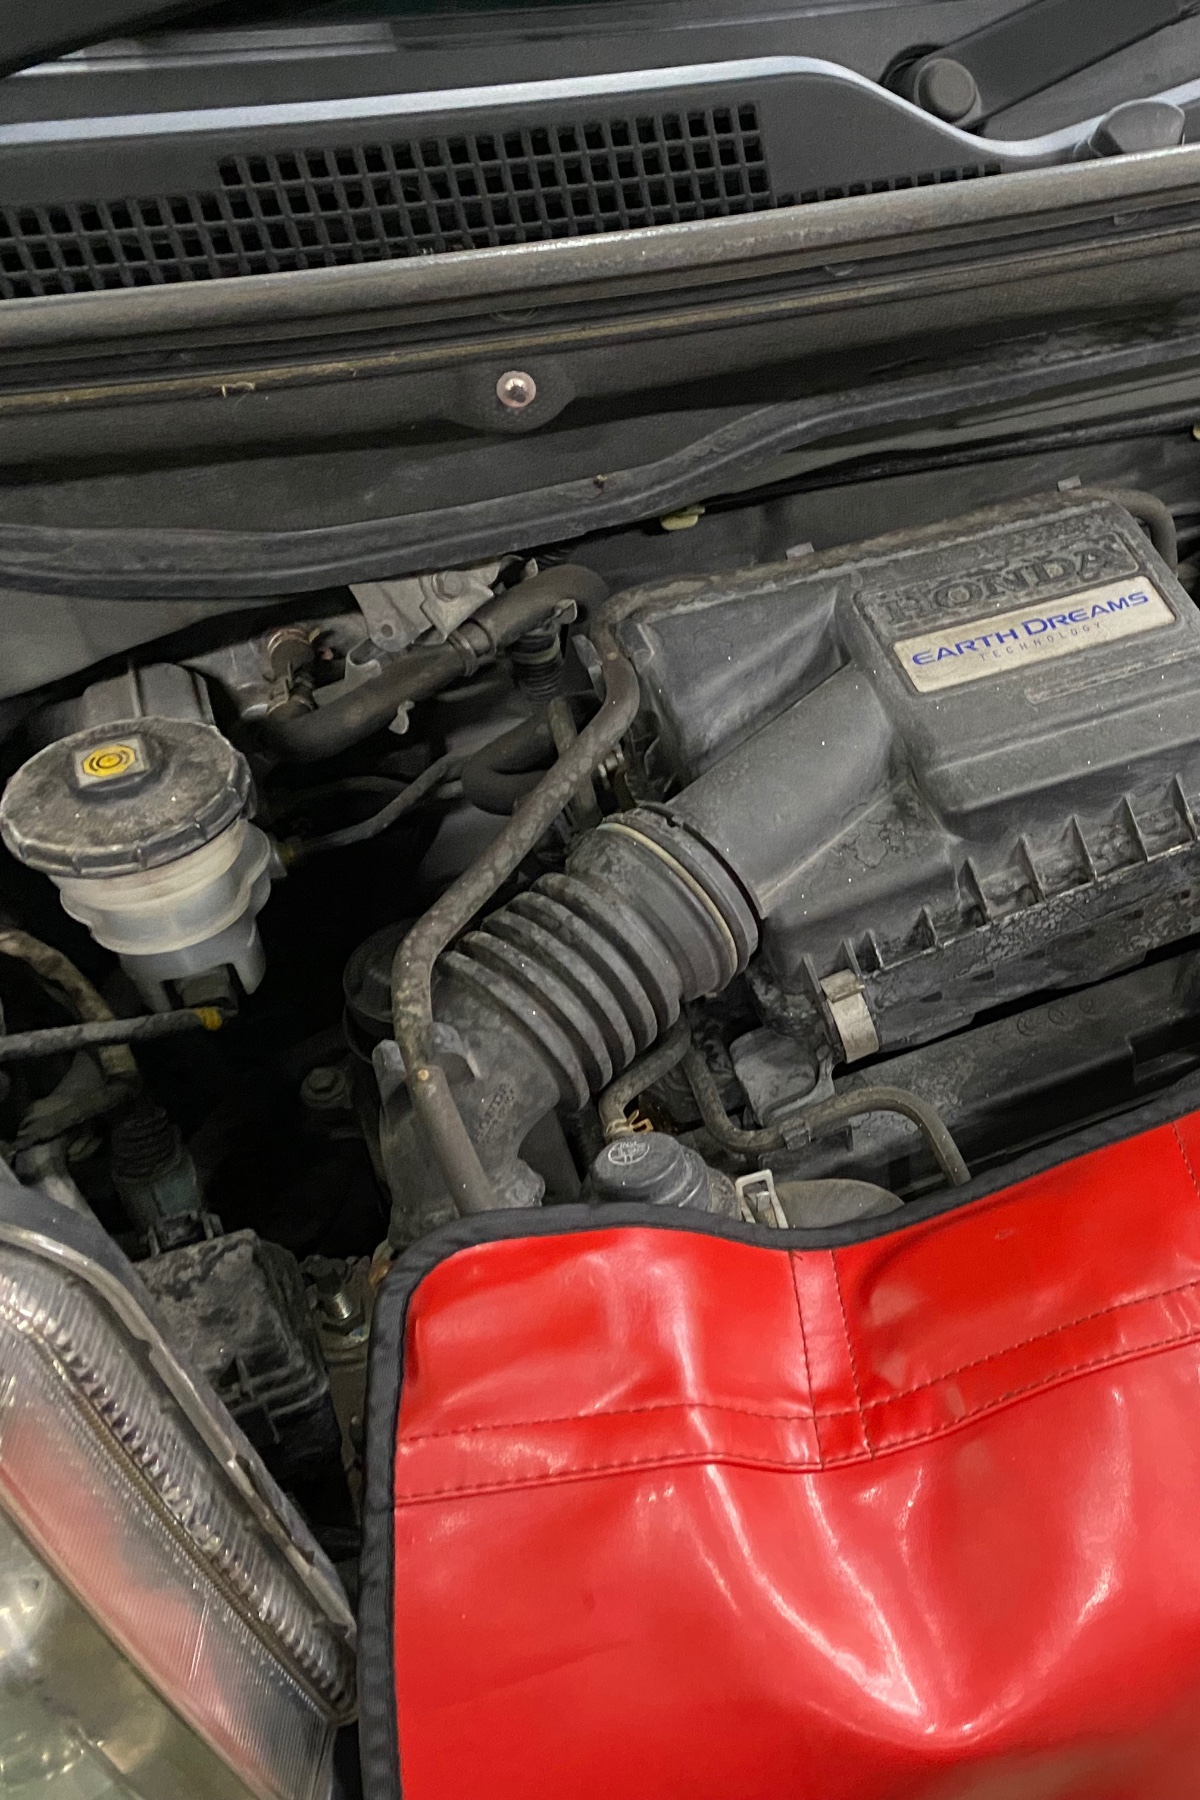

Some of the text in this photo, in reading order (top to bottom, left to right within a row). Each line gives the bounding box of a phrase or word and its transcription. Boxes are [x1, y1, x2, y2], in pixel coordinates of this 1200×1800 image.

[884, 543, 1118, 622] HONDA
[912, 591, 1149, 665] EARTH DREAMS
[979, 621, 1102, 662] TECHNOLOGY
